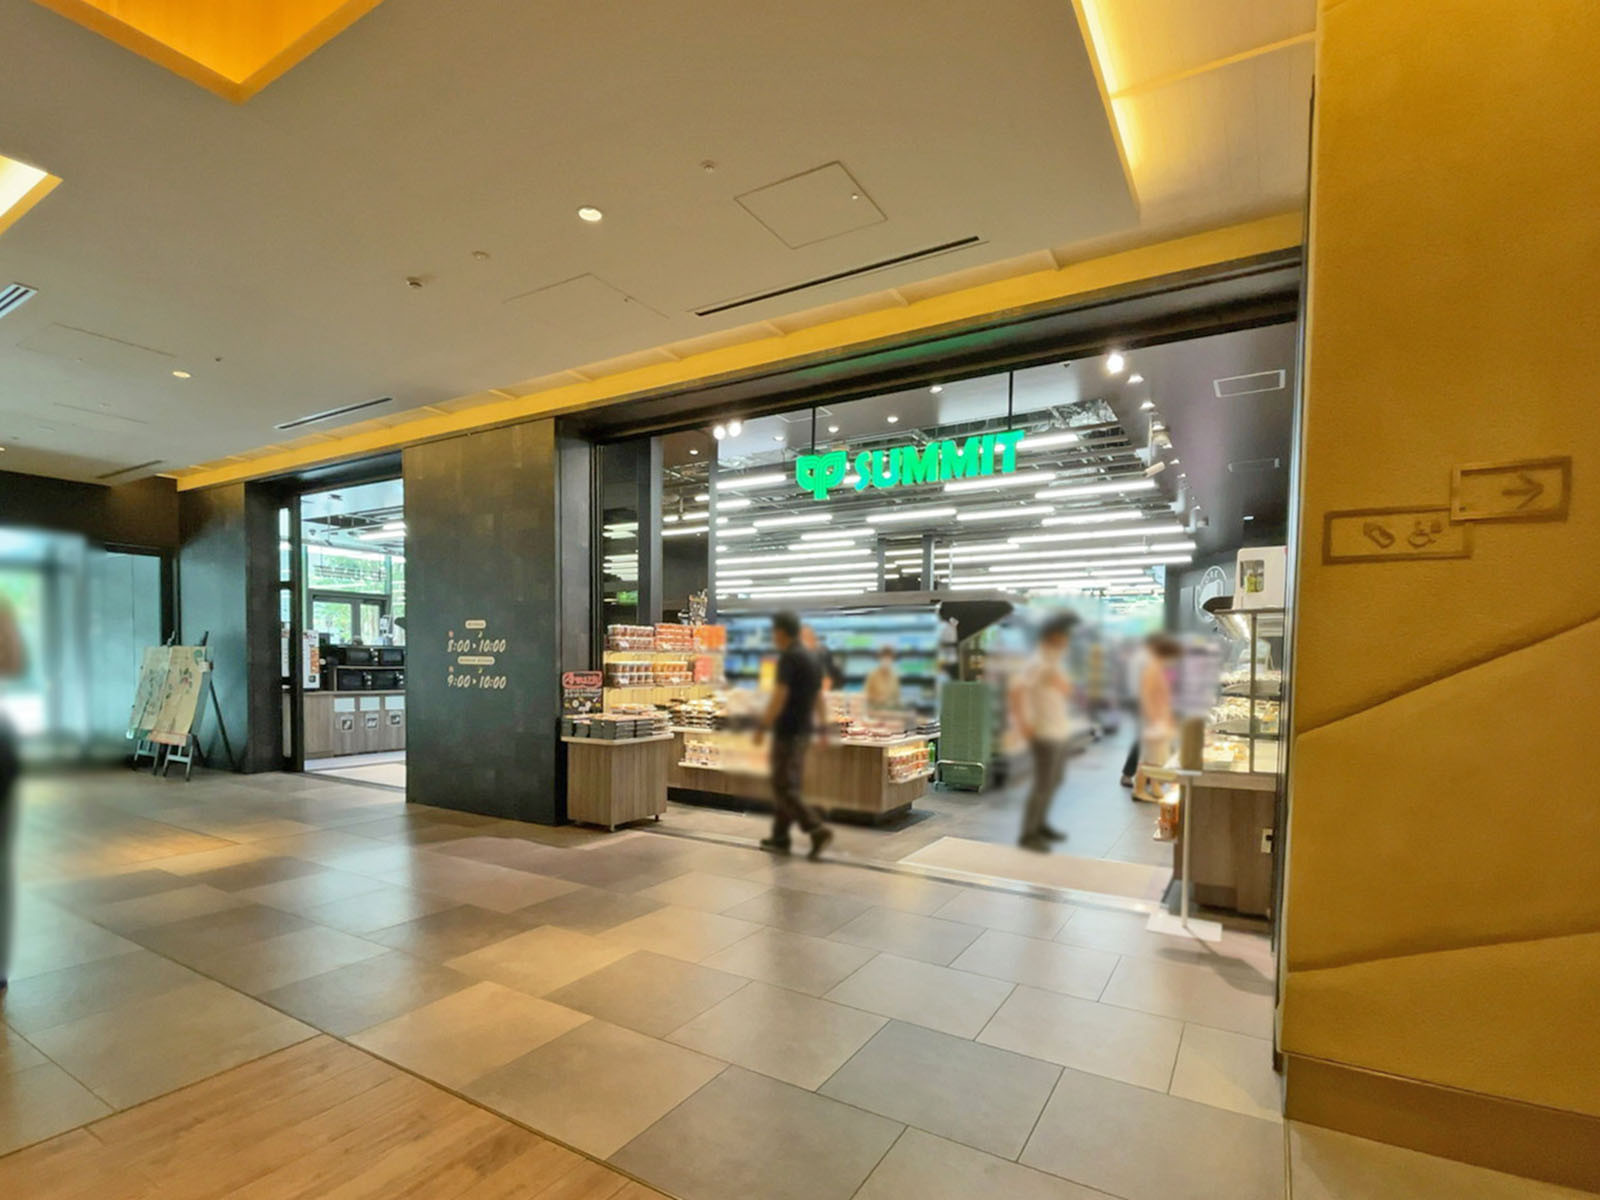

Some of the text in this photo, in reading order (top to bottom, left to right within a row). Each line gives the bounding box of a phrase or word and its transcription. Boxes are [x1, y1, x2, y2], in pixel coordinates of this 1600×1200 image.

[854, 429, 1025, 491] SUMMIT
[479, 639, 506, 653] 10:00
[447, 674, 507, 689] 9:00 10:00
